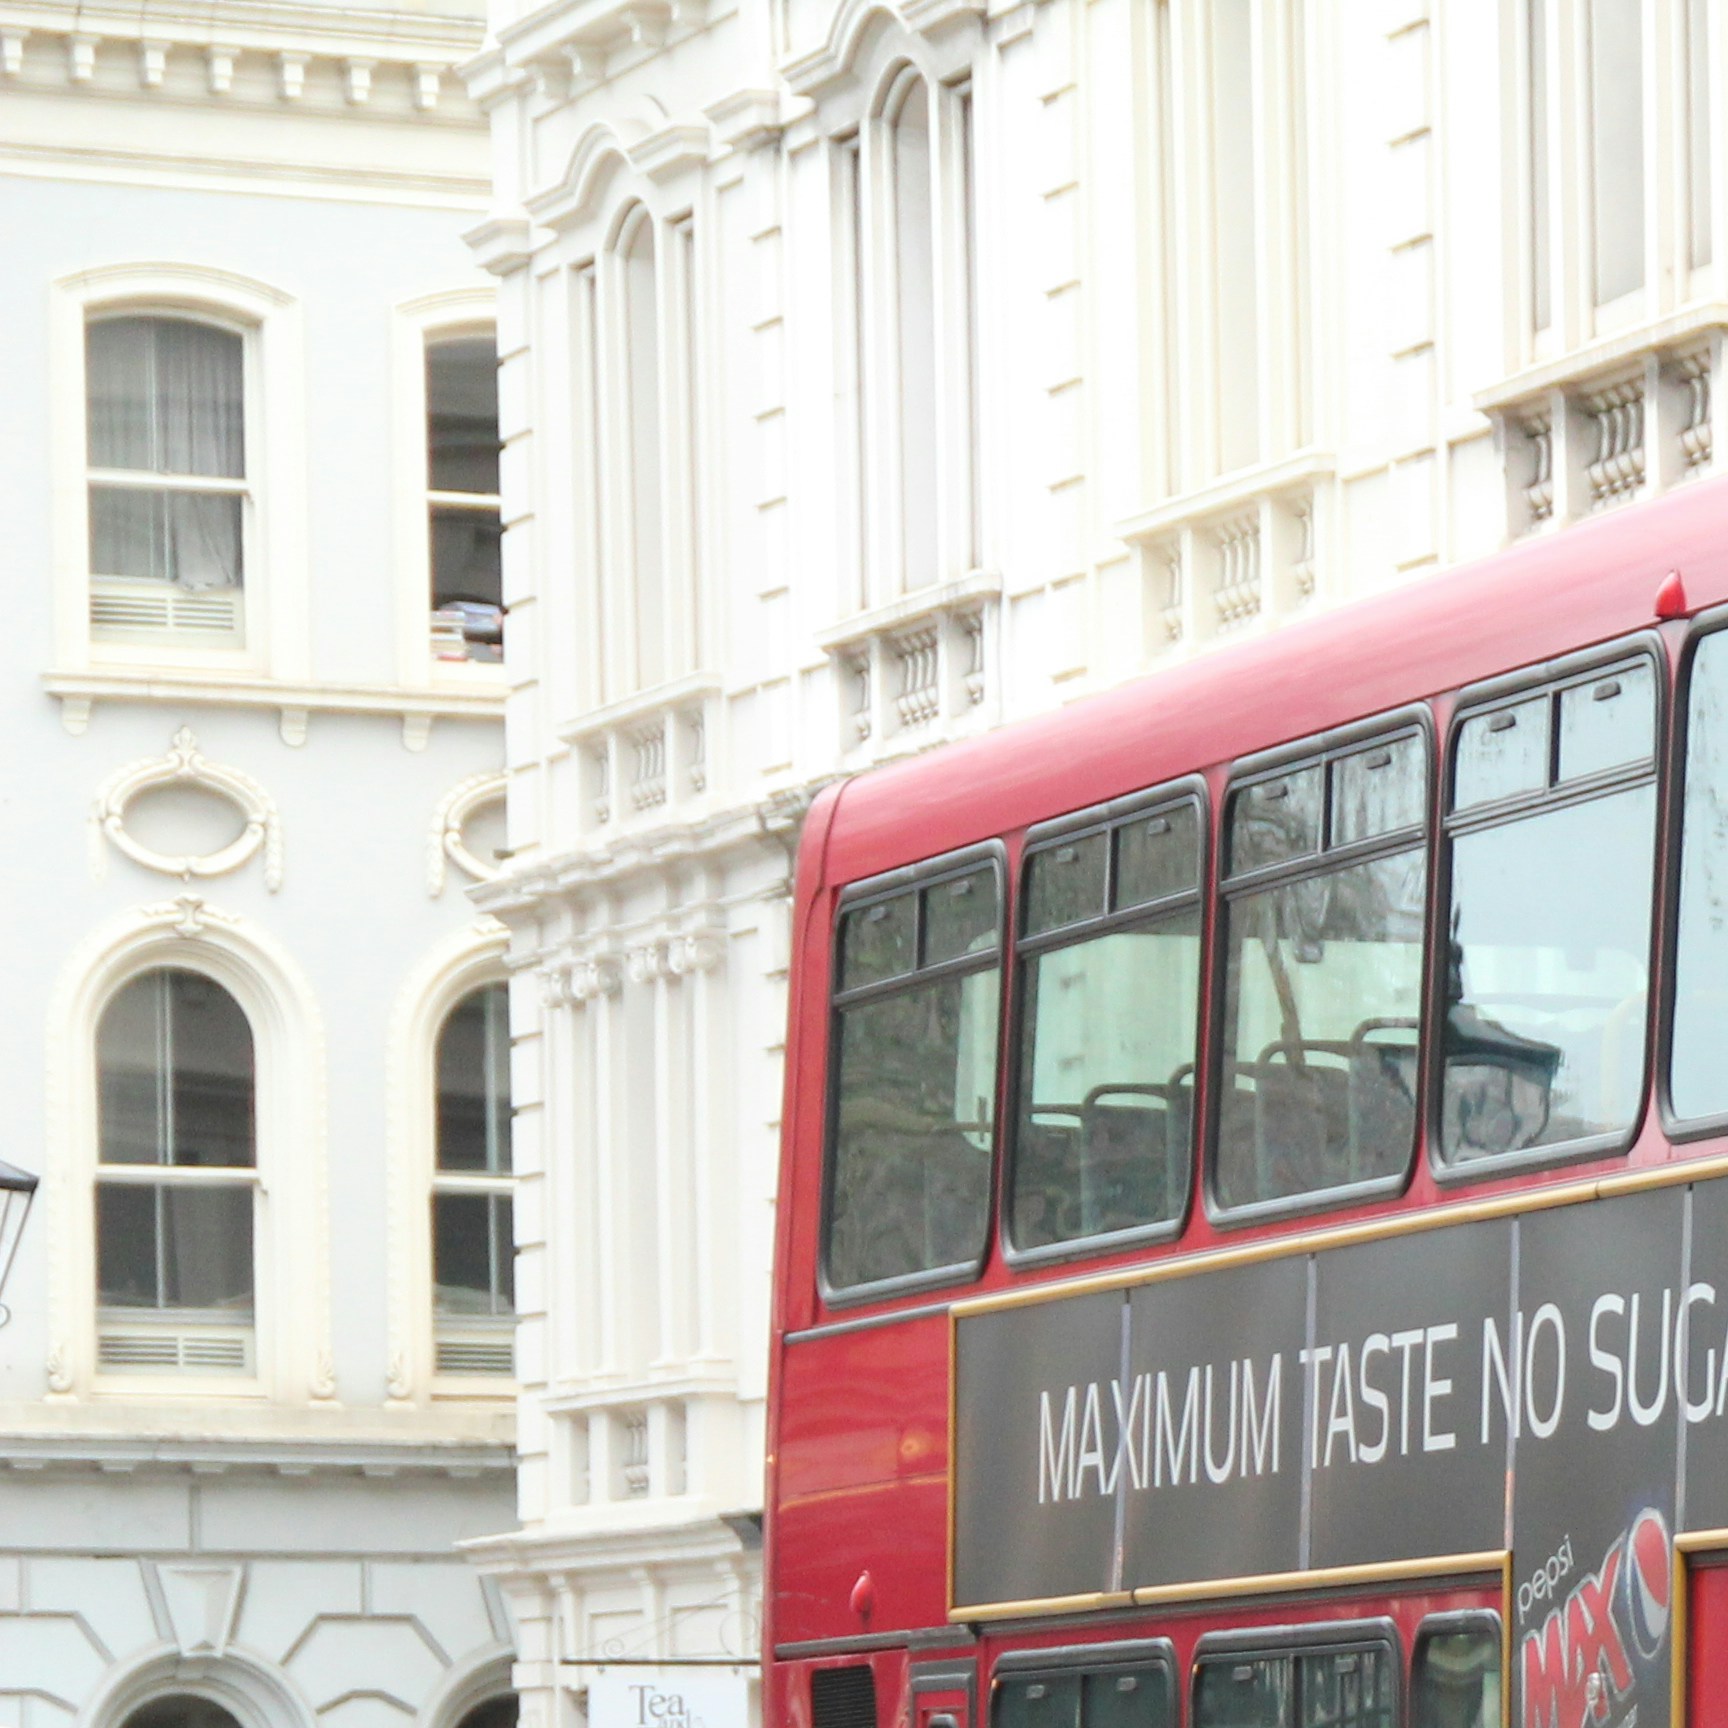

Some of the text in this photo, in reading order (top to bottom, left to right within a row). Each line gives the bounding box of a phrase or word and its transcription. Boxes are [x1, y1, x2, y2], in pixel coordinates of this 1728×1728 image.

[1038, 1353, 1282, 1505] MAXIMUM
[1299, 1322, 1459, 1470] TASTE
[1481, 1302, 1567, 1445] NO
[1517, 1533, 1575, 1626] pepsi
[628, 1685, 685, 1725] Tea
